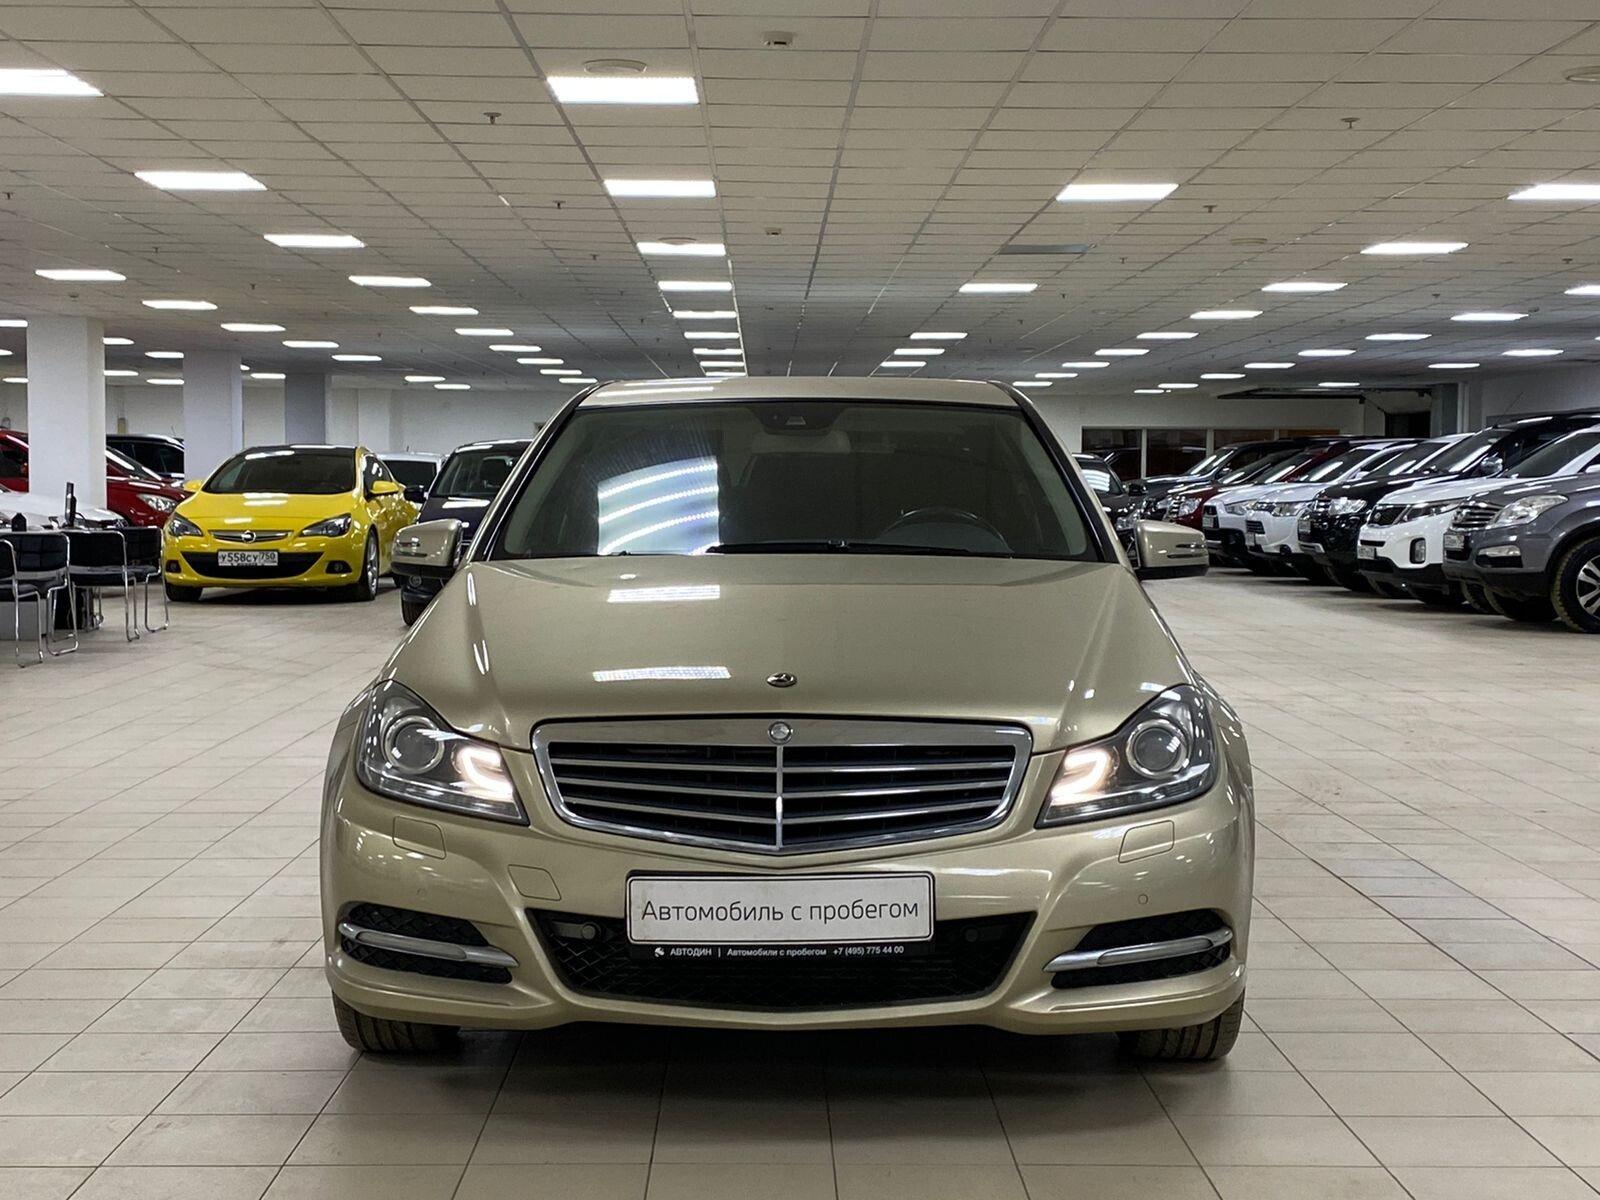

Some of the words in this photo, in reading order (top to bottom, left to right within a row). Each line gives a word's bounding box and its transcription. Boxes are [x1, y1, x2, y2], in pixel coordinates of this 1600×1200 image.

[641, 900, 784, 921] Автомобиль
[791, 905, 802, 921] с
[809, 898, 919, 925] пробегом
[670, 948, 712, 957] АВТОДИН
[727, 948, 778, 957] Автомобили
[786, 948, 827, 957] пробегом
[832, 946, 844, 955] +7
[845, 946, 865, 956] (495)
[866, 946, 881, 955] 775
[882, 946, 892, 954] 44
[893, 945, 905, 954] 00
